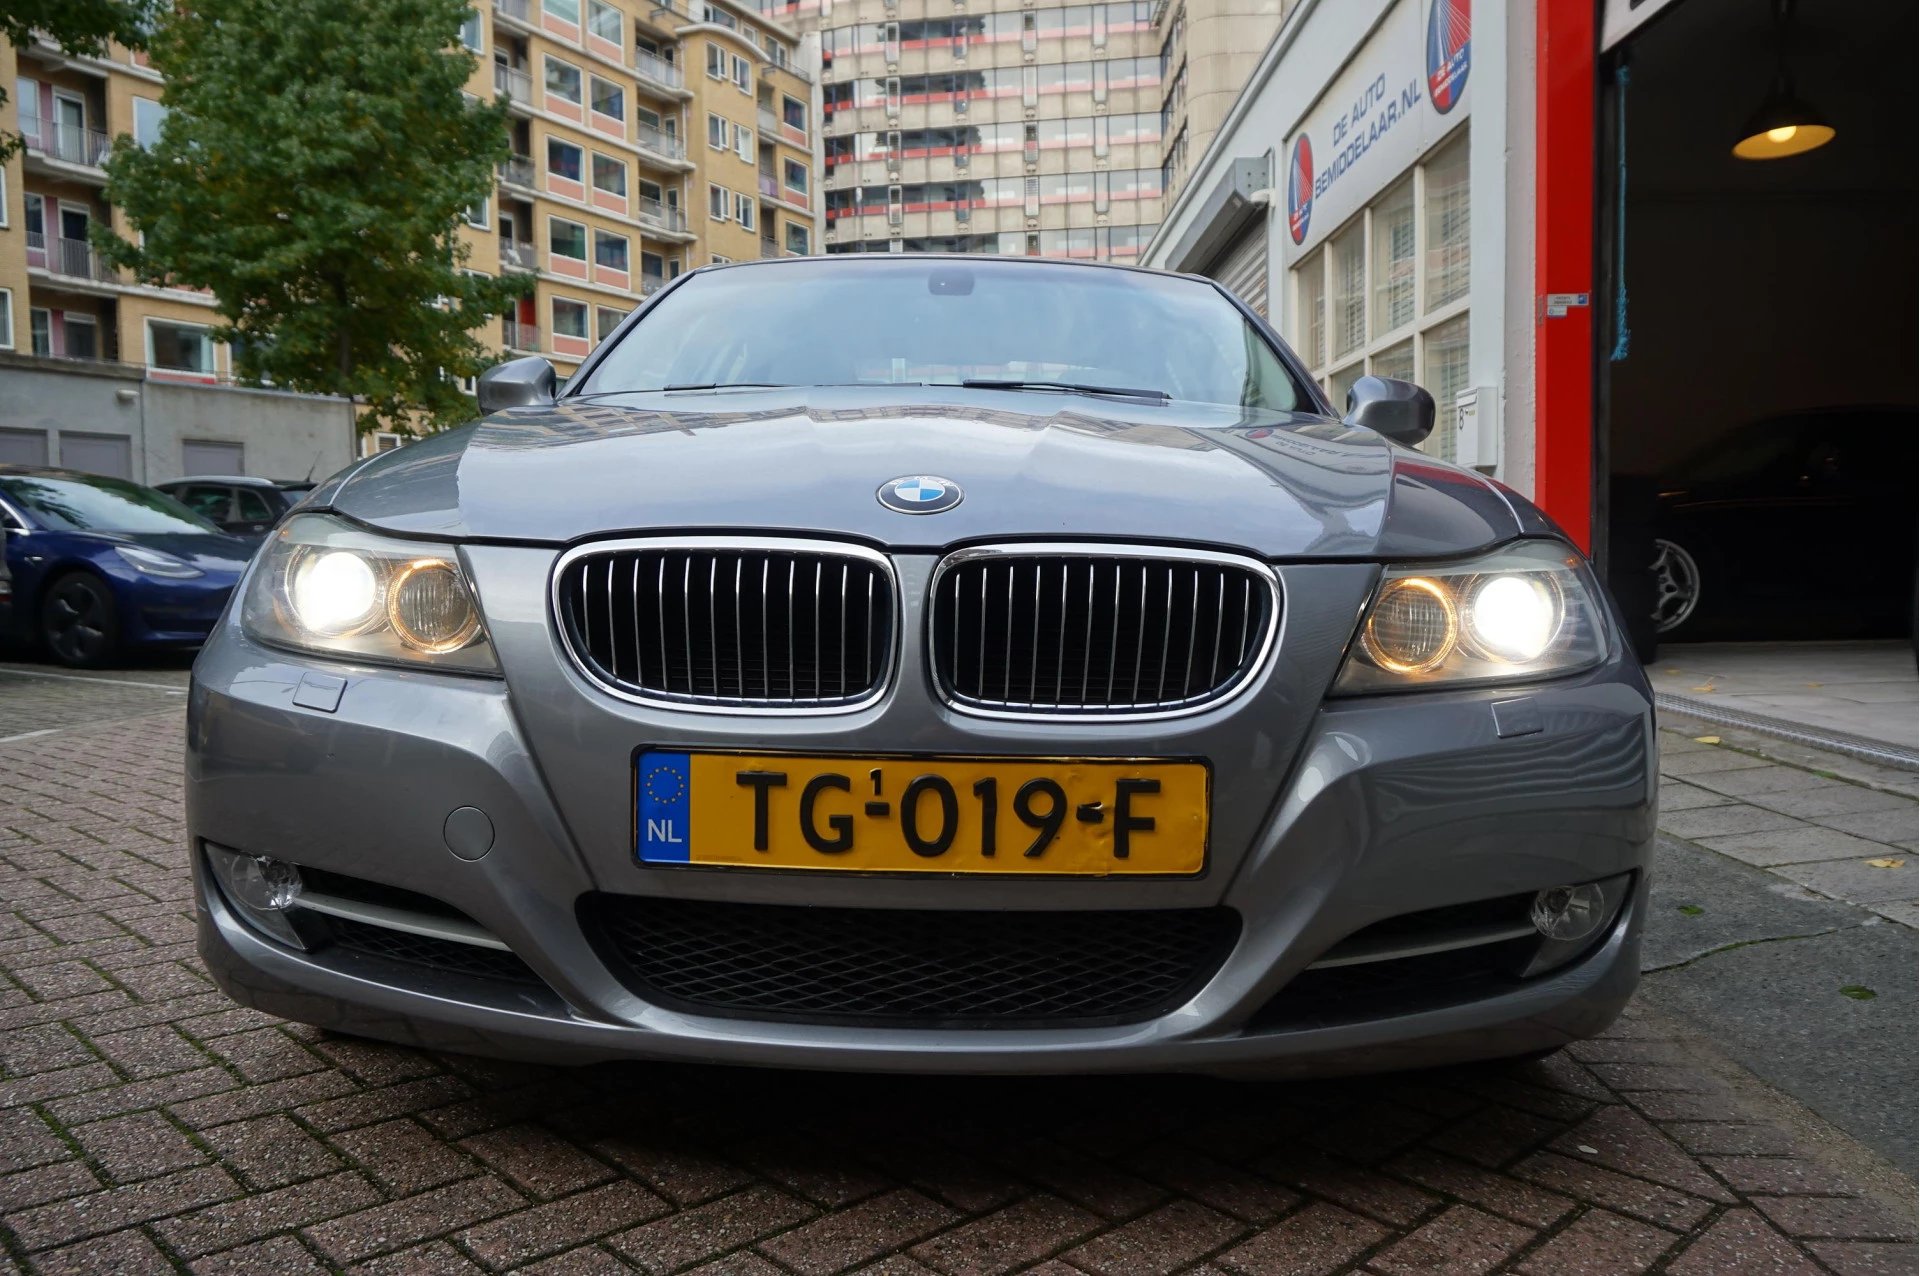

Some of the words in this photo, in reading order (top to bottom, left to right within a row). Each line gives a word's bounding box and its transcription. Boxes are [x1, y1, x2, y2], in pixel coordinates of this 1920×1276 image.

[1333, 113, 1348, 148] DE
[1351, 72, 1386, 128] AUTO
[1315, 78, 1422, 200] BEMIDDELAAR.NL
[1459, 408, 1465, 430] 8
[648, 819, 682, 843] NL
